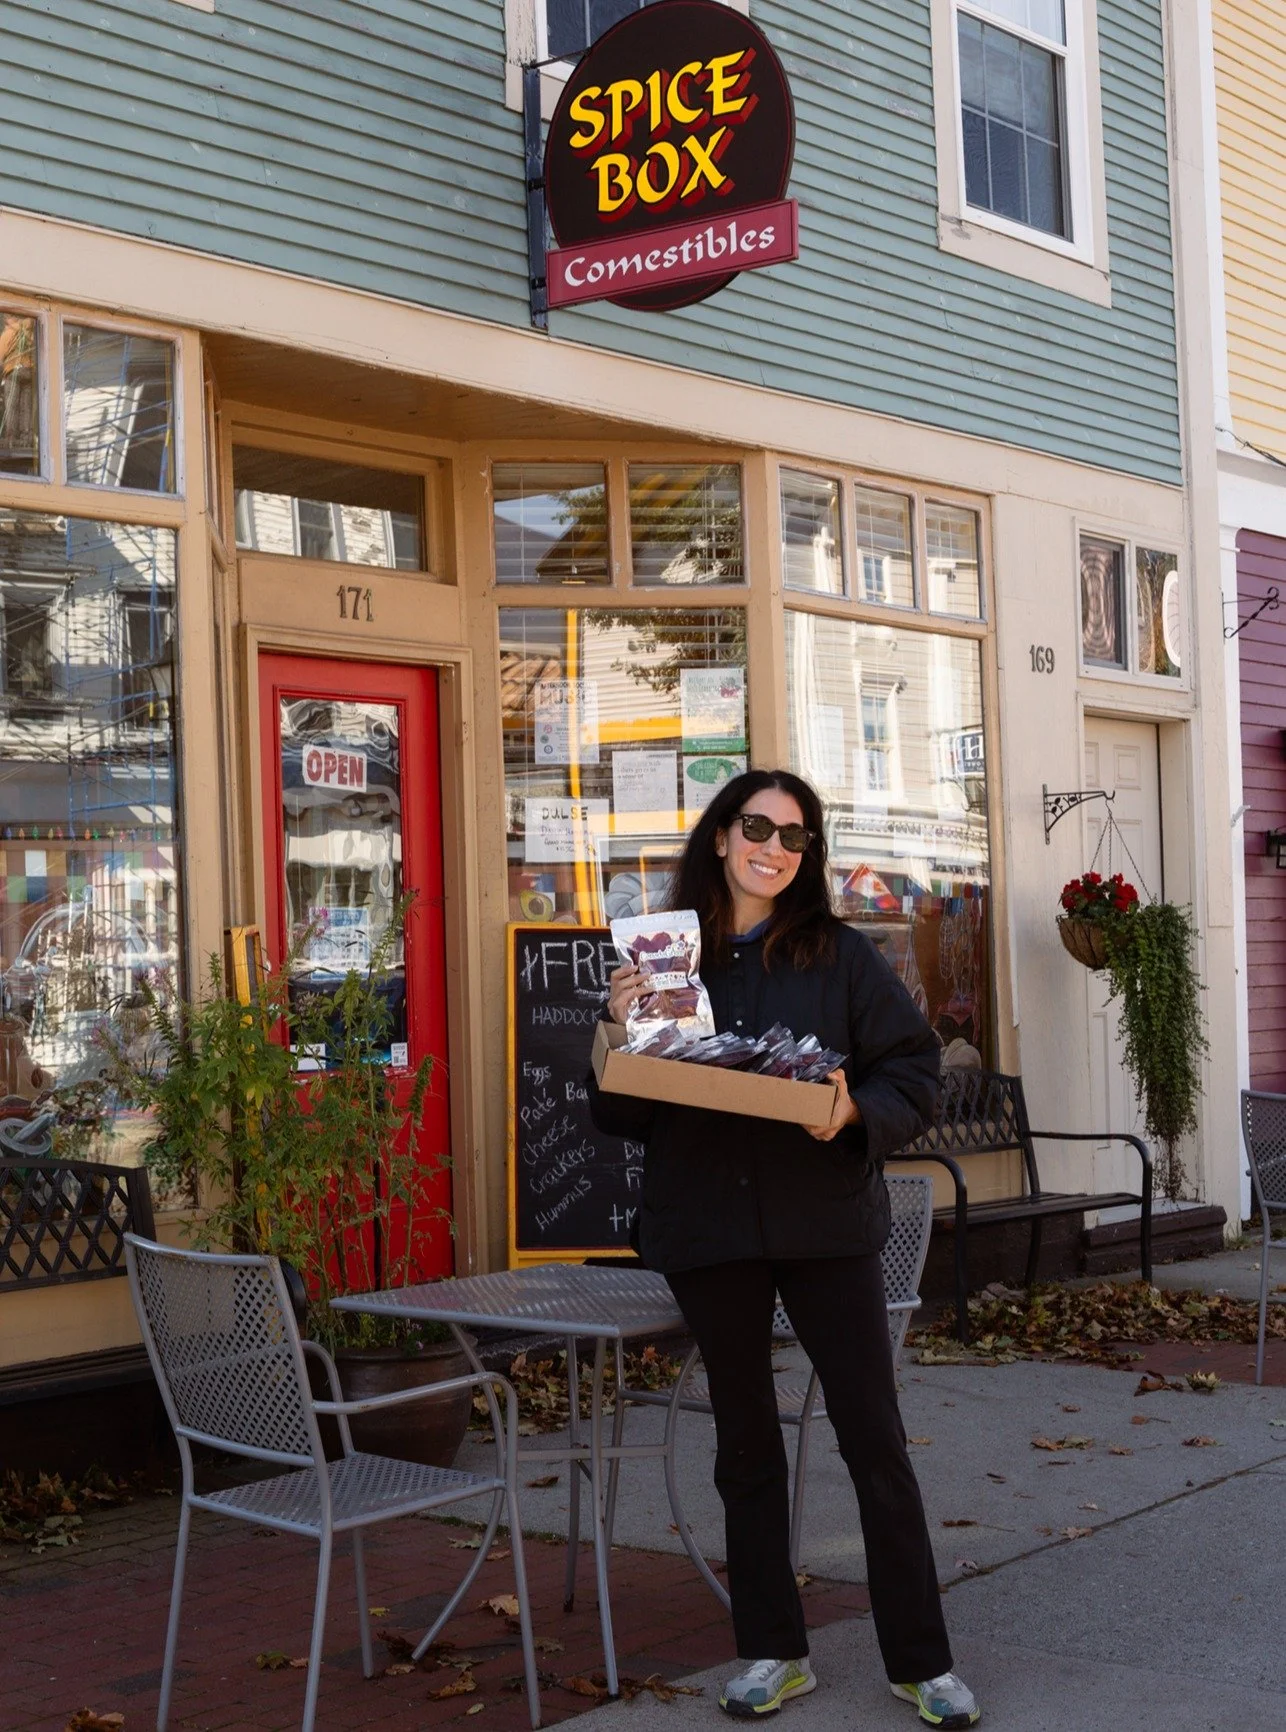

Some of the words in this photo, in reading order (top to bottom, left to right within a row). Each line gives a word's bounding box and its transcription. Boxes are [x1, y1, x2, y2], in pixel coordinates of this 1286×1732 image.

[569, 49, 752, 151] SPICE
[591, 126, 730, 214] BOX
[564, 221, 776, 287] Comestibles
[336, 584, 374, 622] 171
[1029, 644, 1055, 674] 169
[306, 750, 364, 787] OPEN
[541, 806, 588, 820] DULSE
[532, 1006, 602, 1026] HADDOCK
[523, 1061, 552, 1085] Eggs
[523, 1115, 577, 1165] Cheese
[535, 1174, 592, 1230] Hummus
